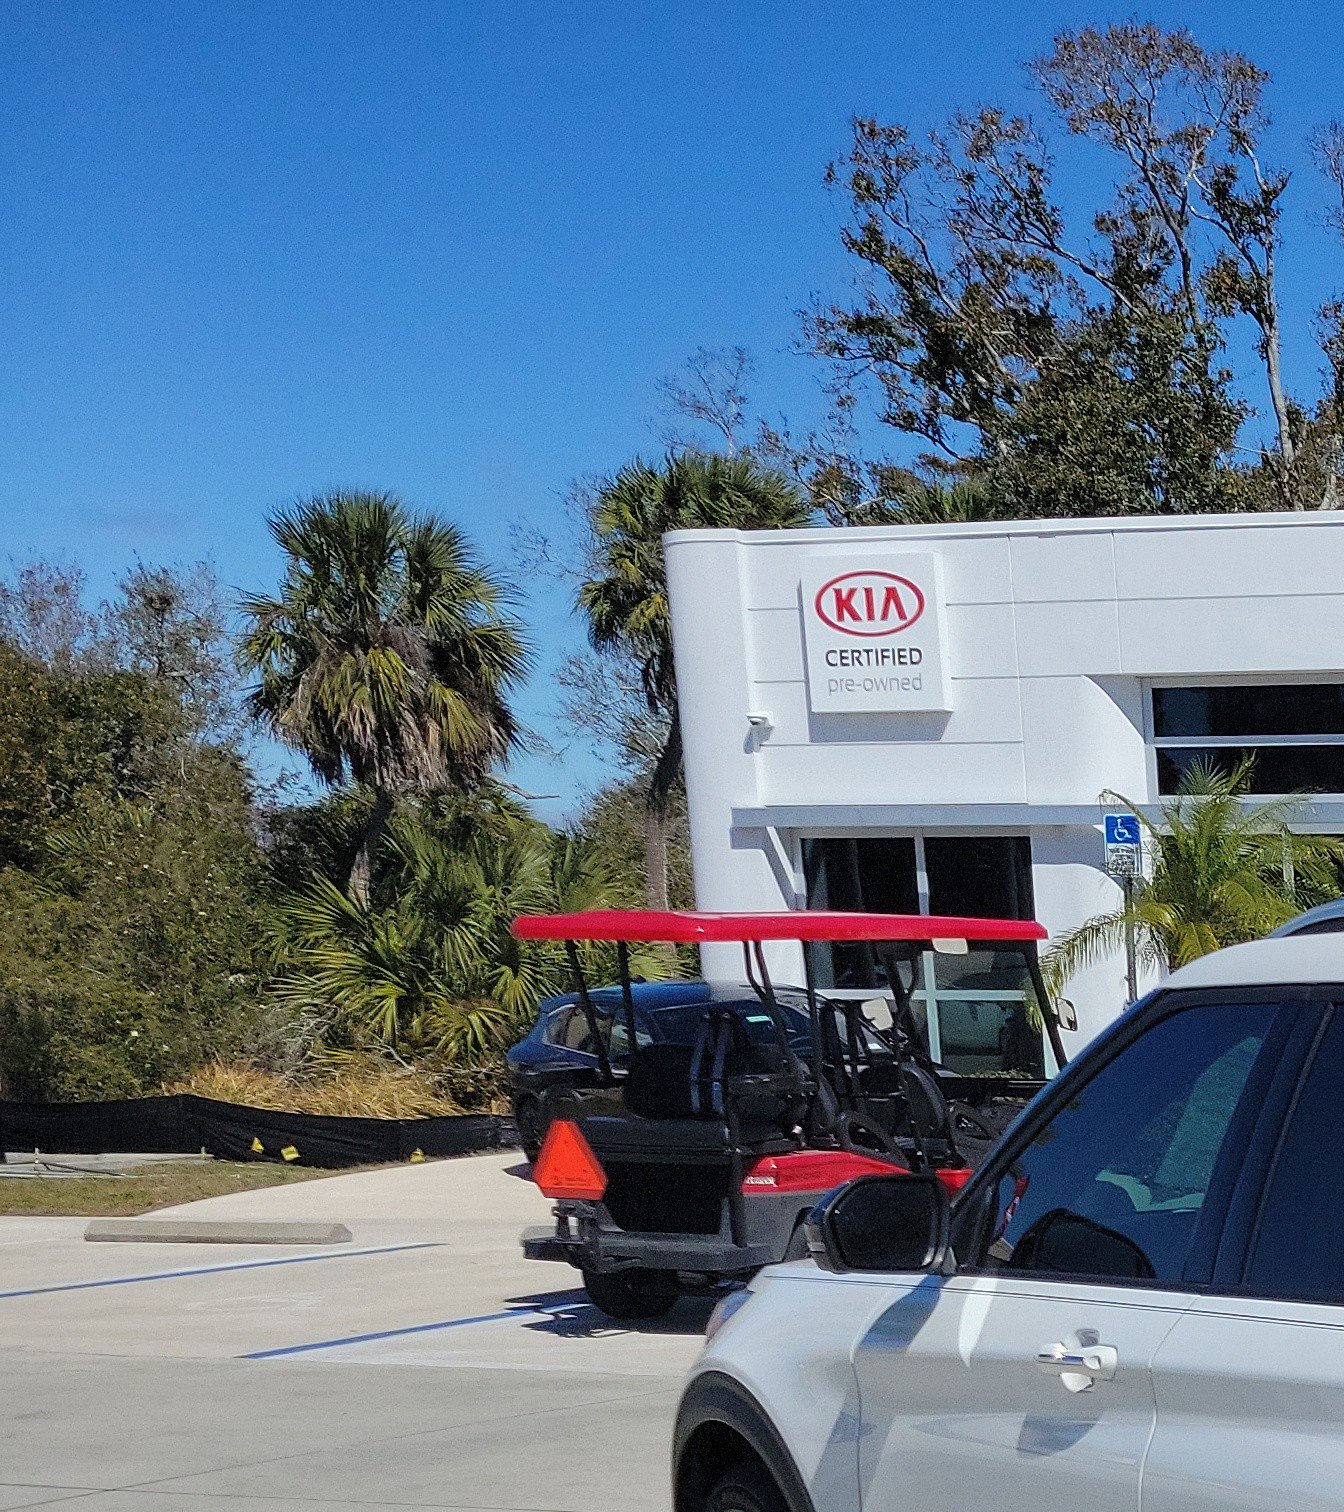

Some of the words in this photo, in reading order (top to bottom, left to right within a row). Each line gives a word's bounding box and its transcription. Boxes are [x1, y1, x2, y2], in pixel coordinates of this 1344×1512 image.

[832, 586, 908, 623] KIA
[825, 647, 923, 667] CERTIFIED
[828, 673, 923, 696] pre-owned
